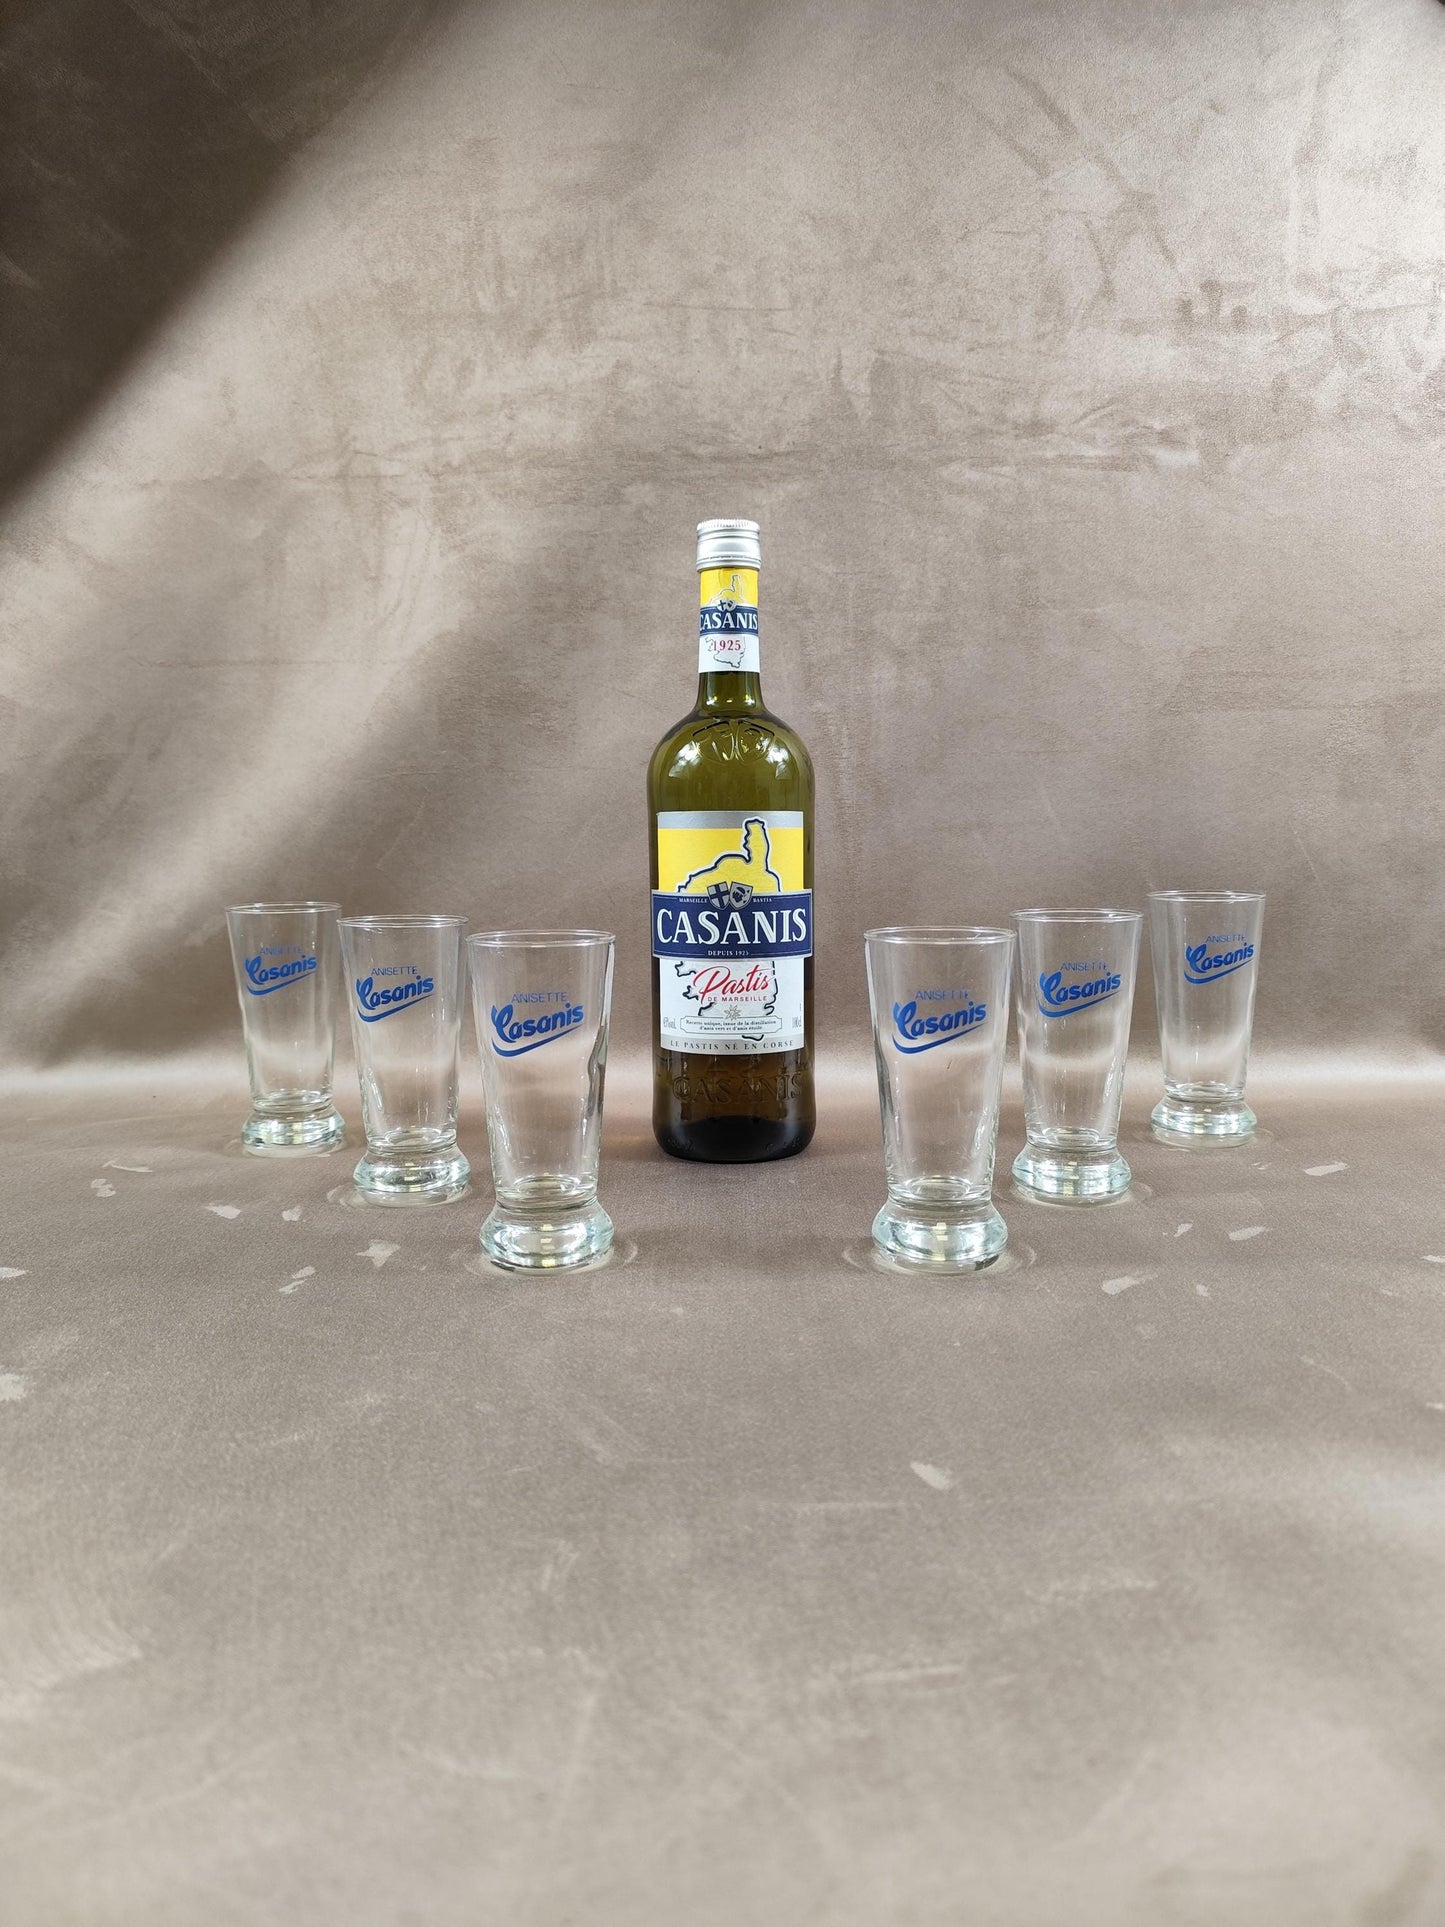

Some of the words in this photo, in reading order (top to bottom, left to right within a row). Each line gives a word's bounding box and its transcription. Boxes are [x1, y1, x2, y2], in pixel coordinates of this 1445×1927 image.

[713, 639, 742, 651] 1925
[657, 908, 807, 945] CASANIS
[1205, 934, 1248, 944] ANISETTE
[245, 955, 318, 985] Casanis
[371, 966, 418, 977] ANISETTE
[1060, 960, 1110, 972] ANISETTE
[1186, 943, 1254, 974] Casanis
[356, 975, 434, 1011] Casanis
[511, 991, 568, 1003] ANISETTE
[692, 964, 772, 1004] Pastis
[721, 995, 769, 1003] MARSEILLE
[1039, 971, 1121, 1006] Casanis
[490, 1002, 585, 1044] Casanis
[892, 1000, 988, 1041] Casanis
[670, 1040, 680, 1048] LE
[684, 1042, 719, 1050] PASTIS
[725, 1041, 738, 1051] NÉ
[744, 1042, 757, 1051] EN
[763, 1040, 794, 1049] CORSE
